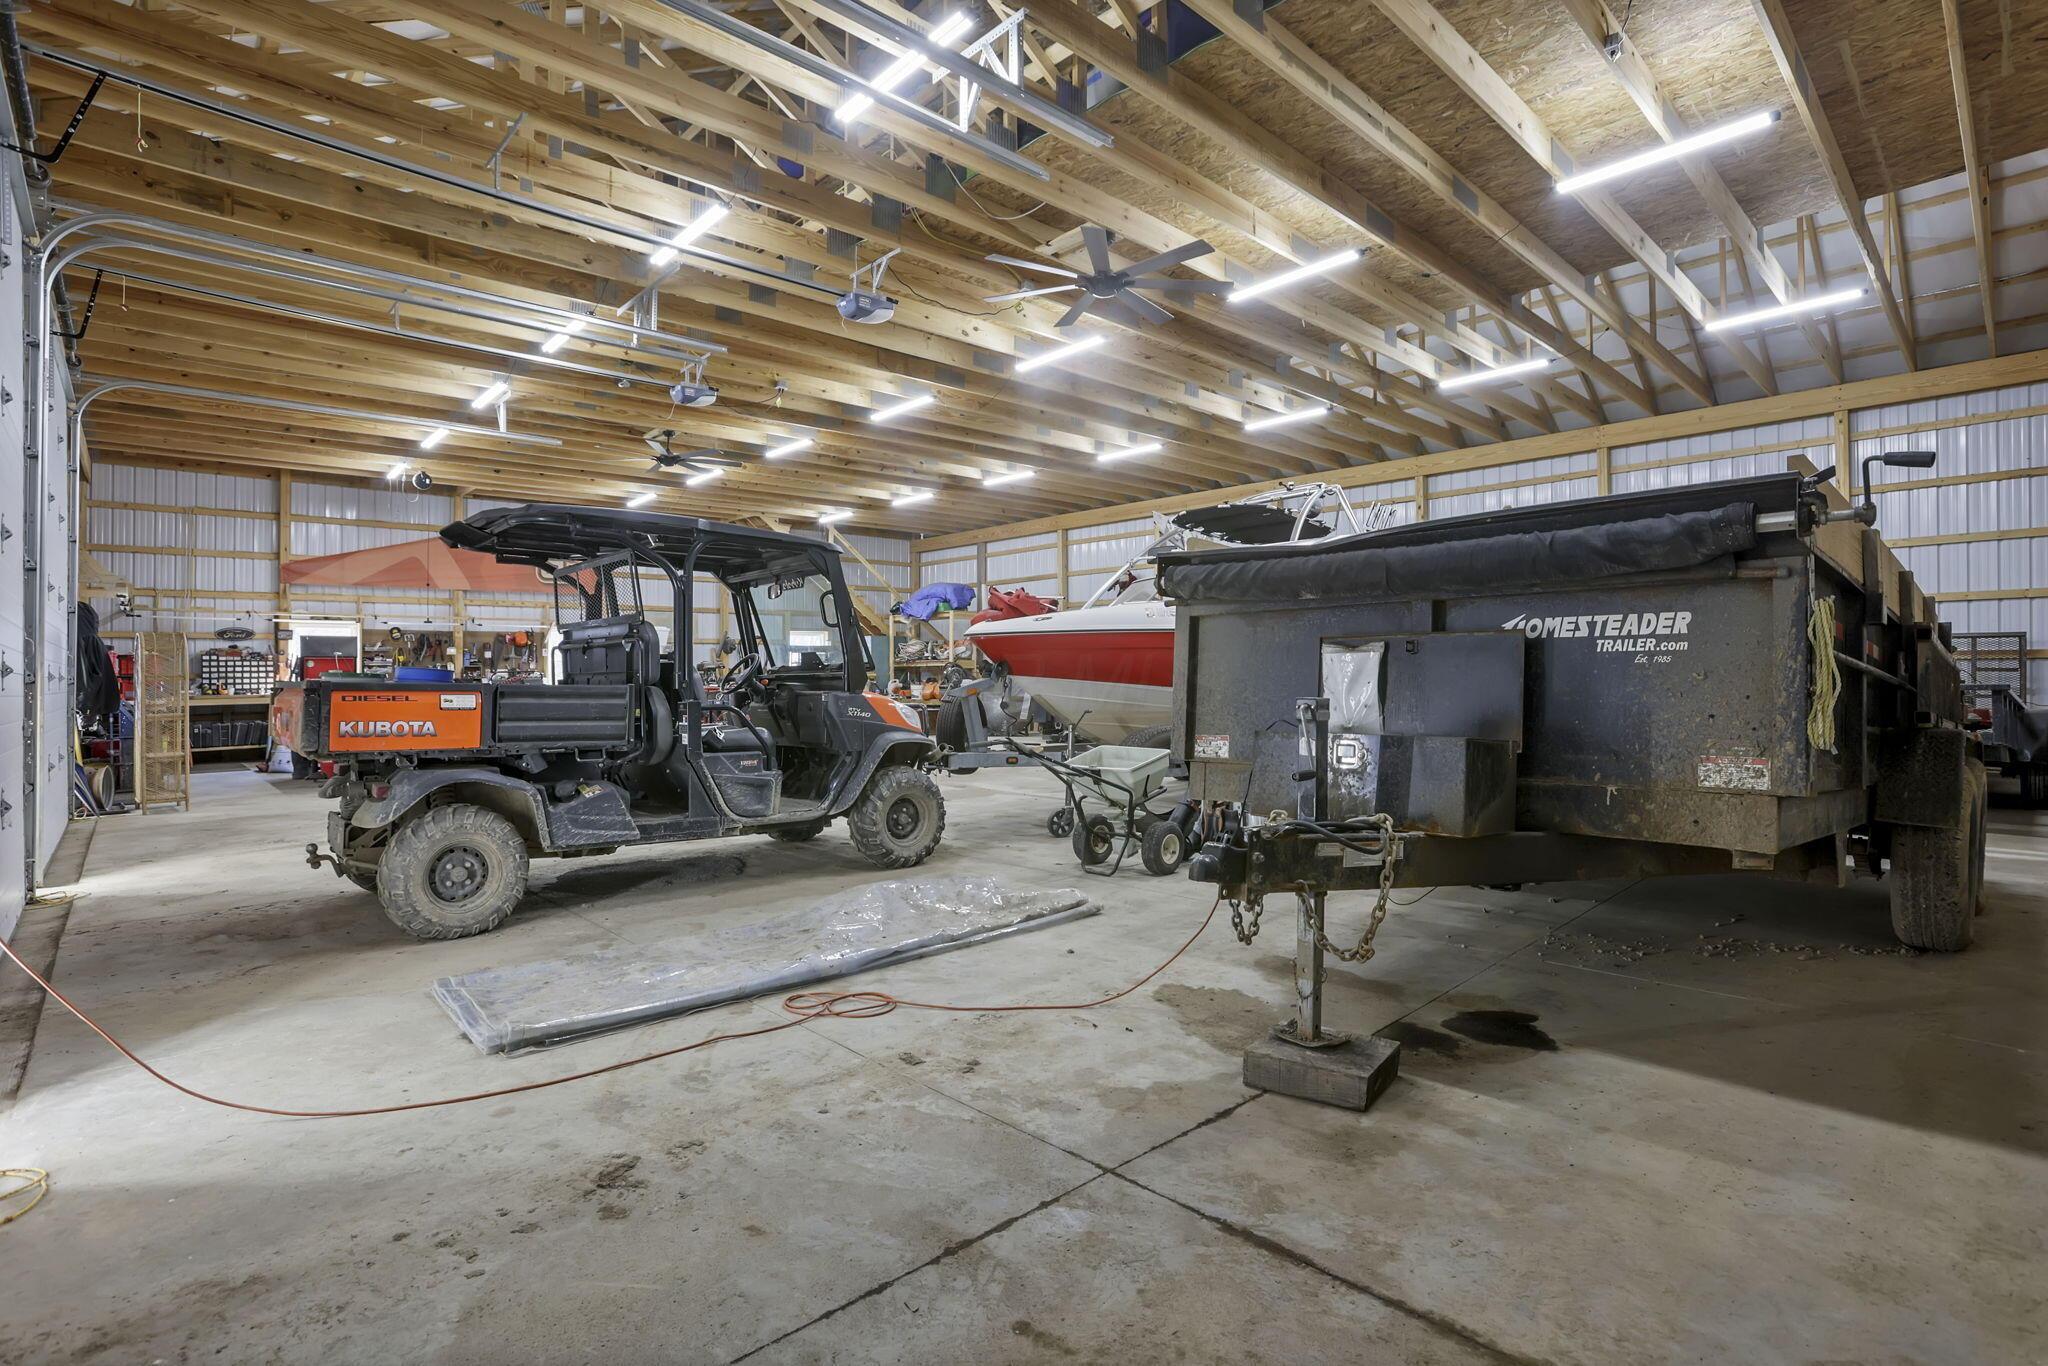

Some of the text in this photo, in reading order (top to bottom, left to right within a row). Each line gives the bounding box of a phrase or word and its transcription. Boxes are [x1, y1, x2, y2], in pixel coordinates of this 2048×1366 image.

[1596, 638, 1688, 652] TRAILER.com
[1653, 655, 1673, 664] 1985
[339, 721, 437, 737] KUBOTA
